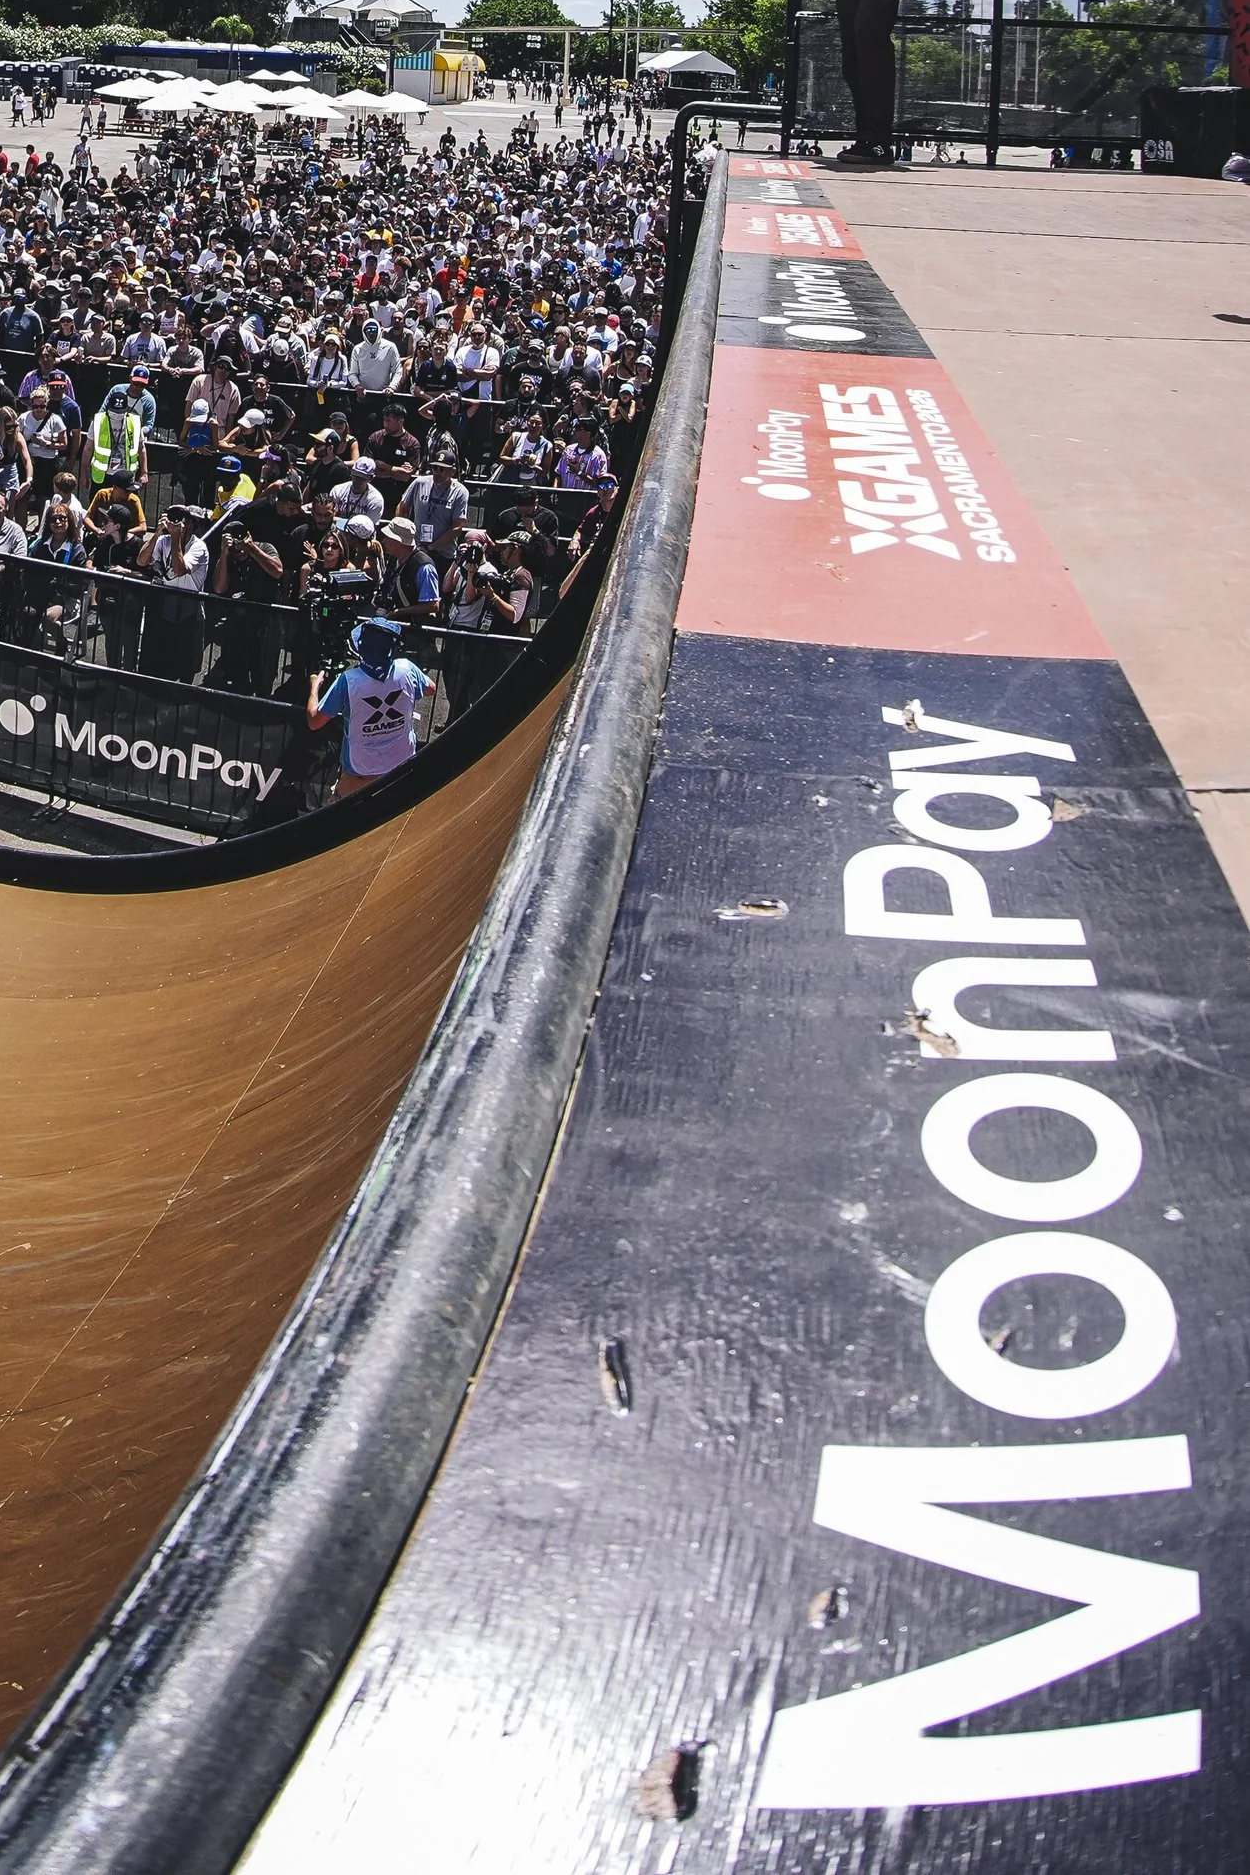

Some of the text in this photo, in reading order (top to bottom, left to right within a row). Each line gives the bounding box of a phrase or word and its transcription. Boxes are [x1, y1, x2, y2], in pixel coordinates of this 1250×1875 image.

[776, 261, 859, 321] MoonPay
[757, 409, 811, 479] MoonPay
[818, 383, 962, 561] XGAMES
[54, 712, 283, 802] MoonPay
[361, 717, 406, 733] GAMES
[757, 702, 1203, 1812] MoonPay
